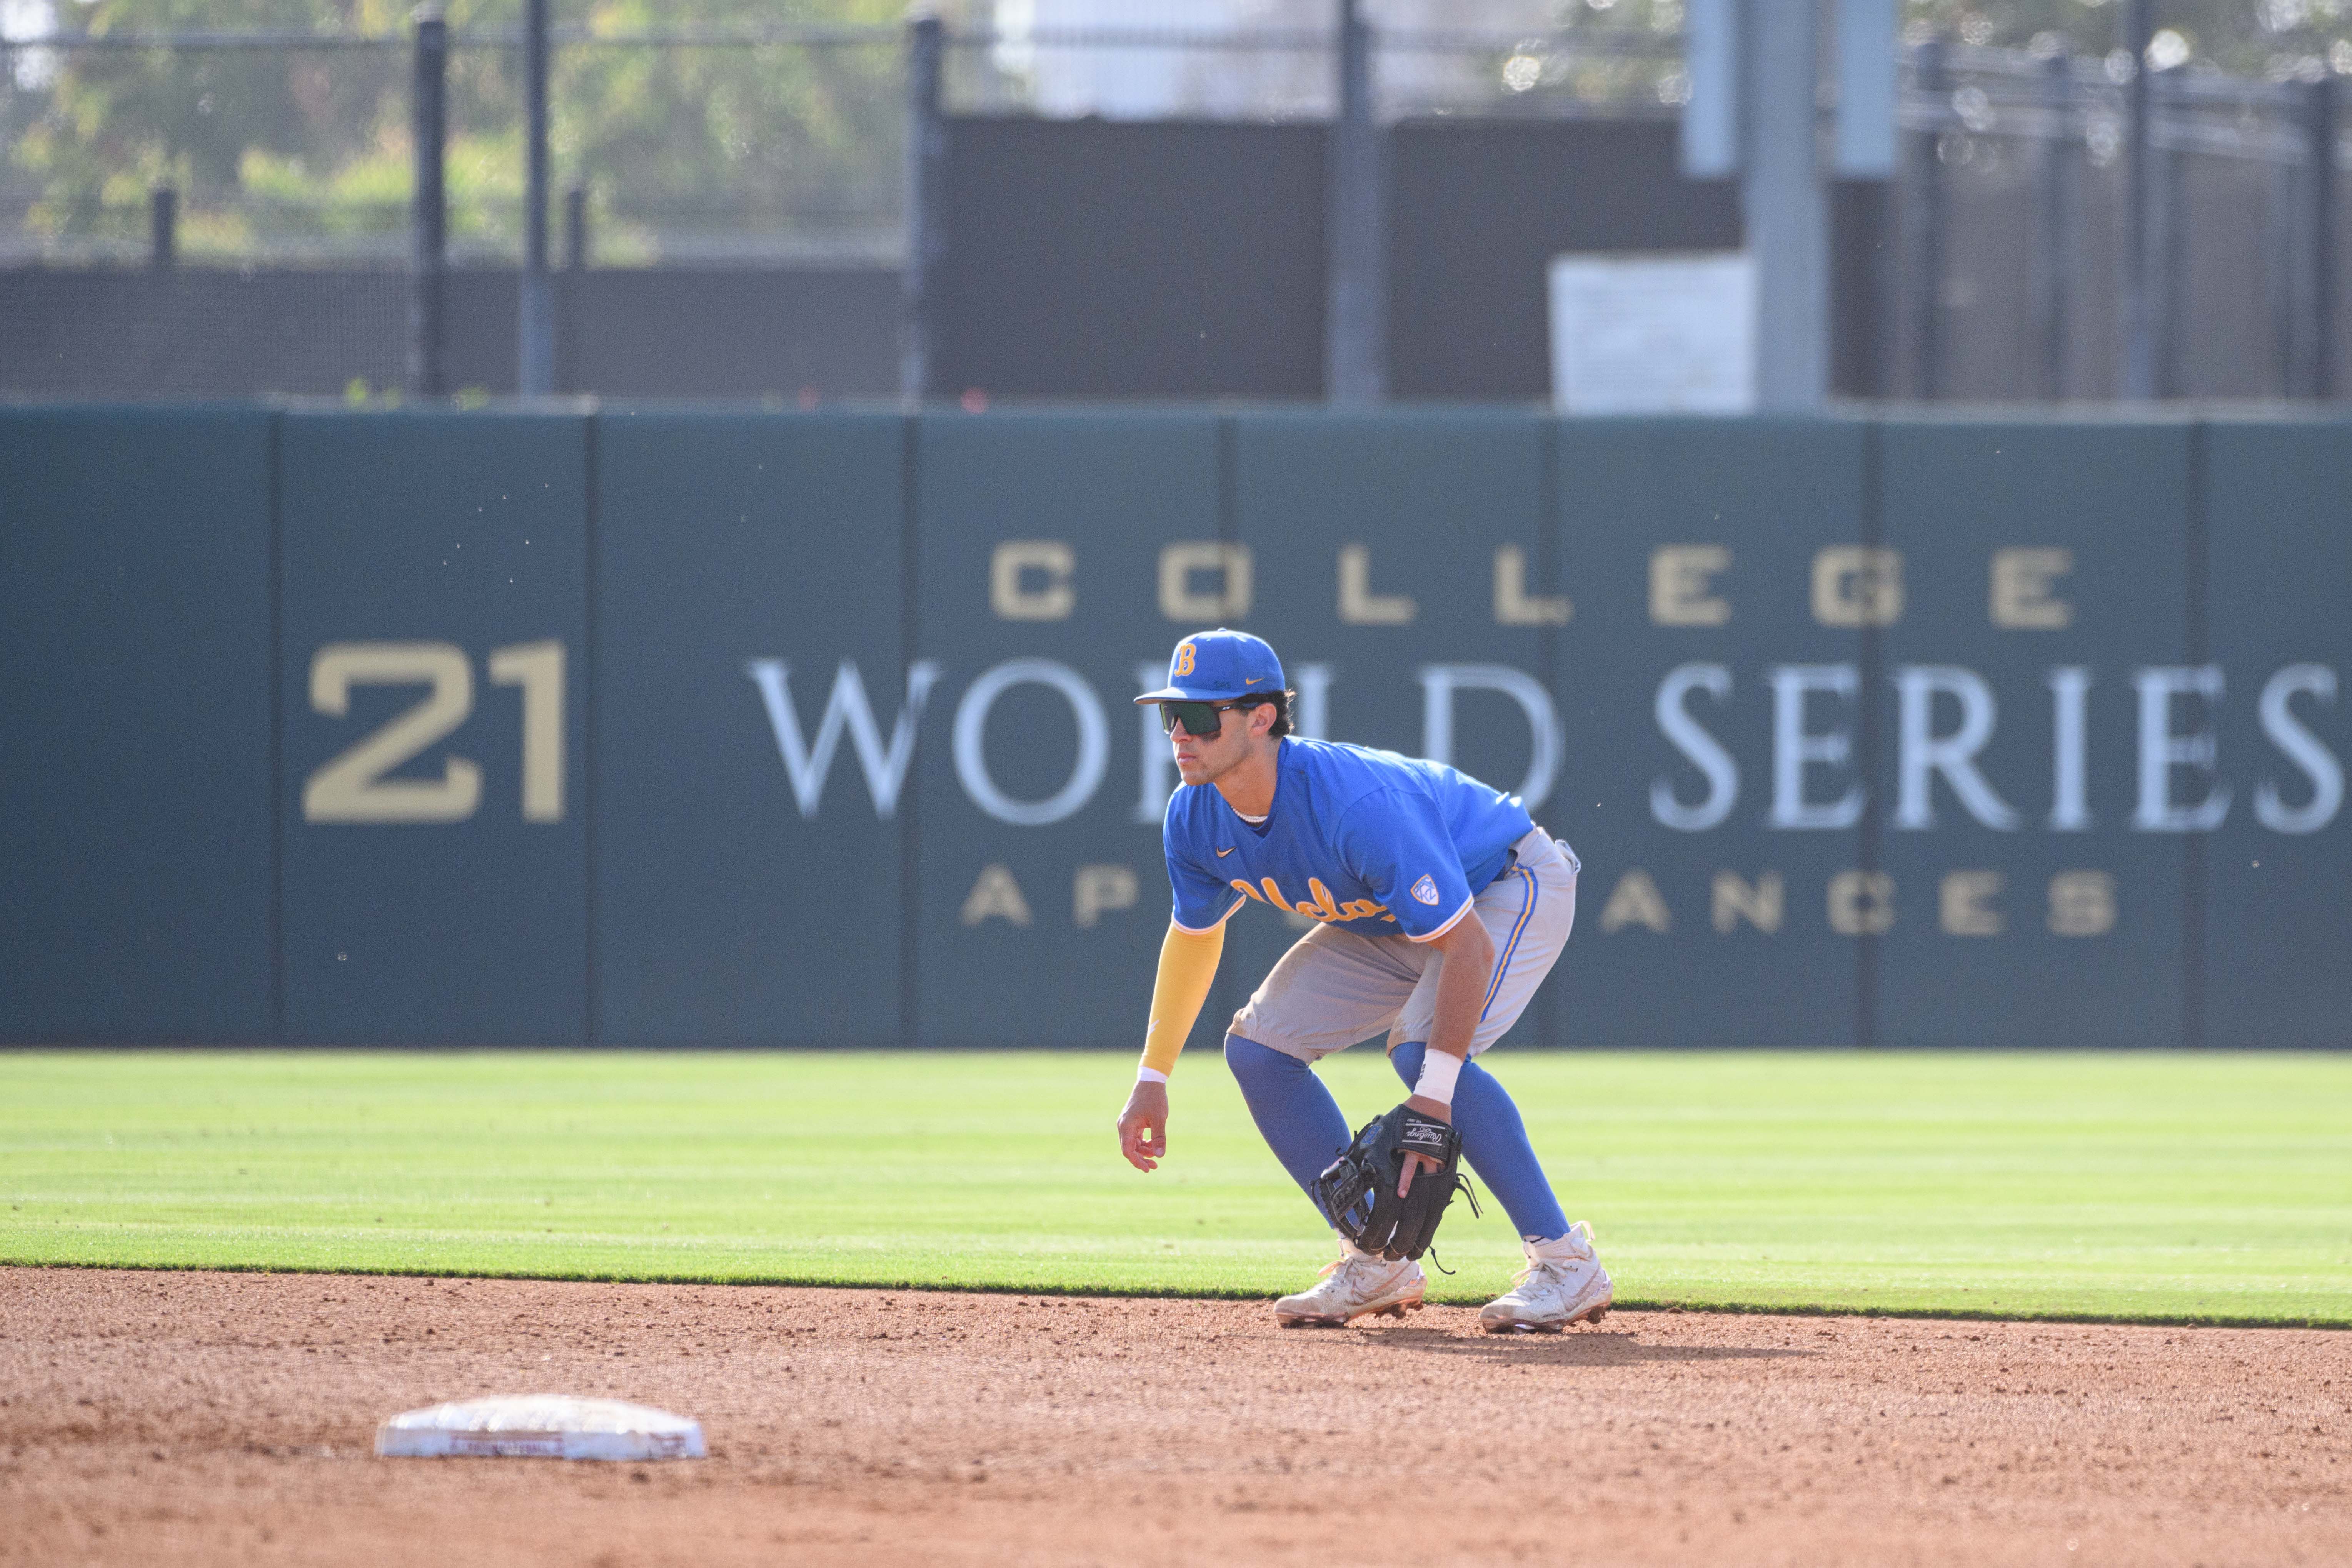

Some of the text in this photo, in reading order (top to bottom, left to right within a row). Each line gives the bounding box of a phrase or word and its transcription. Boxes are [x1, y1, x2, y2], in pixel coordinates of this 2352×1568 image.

[990, 543, 2072, 629] COLLEGE
[1174, 643, 1196, 677] B
[303, 639, 565, 823] 21
[1650, 662, 2344, 832] SERIES
[962, 864, 2117, 935] APANCES
[1406, 1127, 1442, 1143] Rawlings
